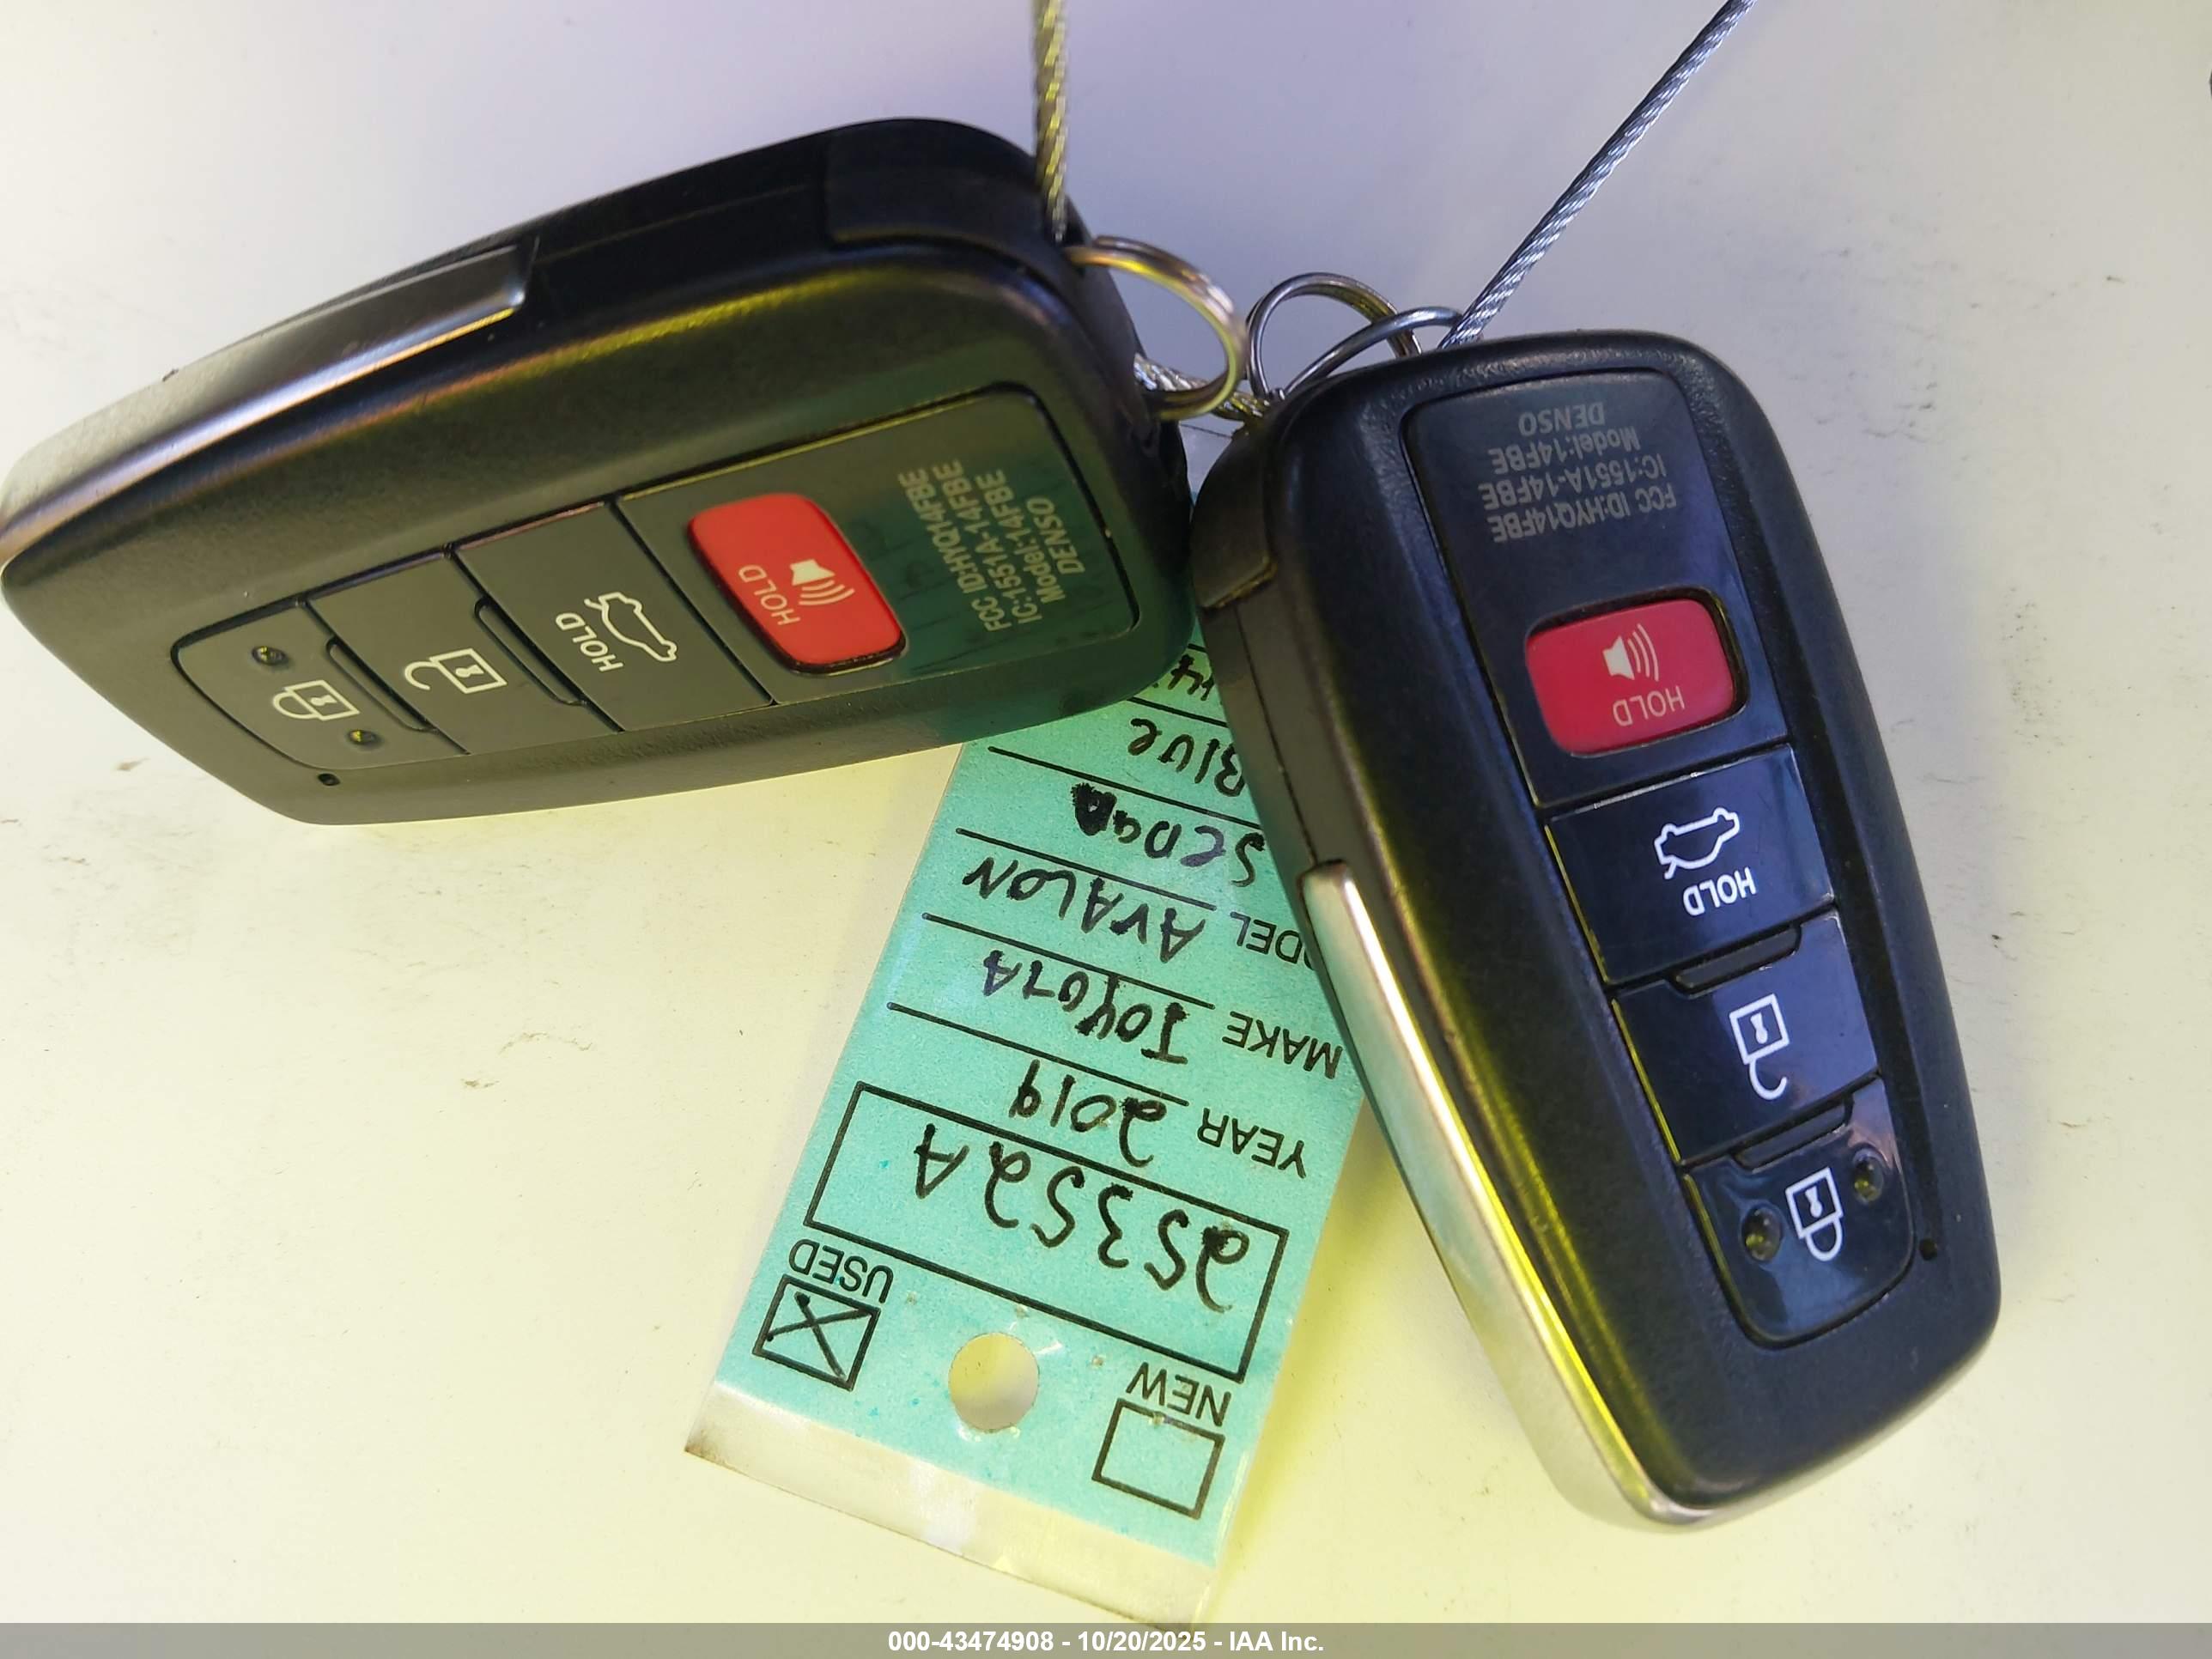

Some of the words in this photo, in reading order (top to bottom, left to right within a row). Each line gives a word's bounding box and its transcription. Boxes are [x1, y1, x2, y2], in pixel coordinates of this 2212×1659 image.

[1487, 426, 1641, 474] Model:14FBE
[1518, 402, 1606, 436] DENSO
[1478, 453, 1667, 510] IC:1551A-14FBE
[1635, 483, 1677, 513] FCC
[898, 468, 988, 593] ID:HYQ14FBE
[932, 459, 1043, 624] IC:1551A-14FBE
[975, 469, 1066, 603] Model:14FBE
[1026, 496, 1085, 574] DENSO
[1487, 491, 1631, 543] ID:HYQ14FBE
[738, 564, 800, 626] HOLD
[971, 597, 1012, 631] FCC
[556, 611, 624, 672] HOLD
[1613, 686, 1686, 726] HOLD
[963, 857, 1206, 963] AVALON
[1683, 866, 1757, 916] HOLD
[1231, 910, 1316, 971] DEL
[983, 949, 1190, 1064] TOYOTA
[1221, 1011, 1344, 1079] MAKE
[1009, 1059, 1167, 1167] 2019
[1197, 1108, 1306, 1177] YEAR
[914, 1122, 1250, 1314] 25352A
[788, 1238, 894, 1304] USED
[1126, 1362, 1231, 1427] NEW
